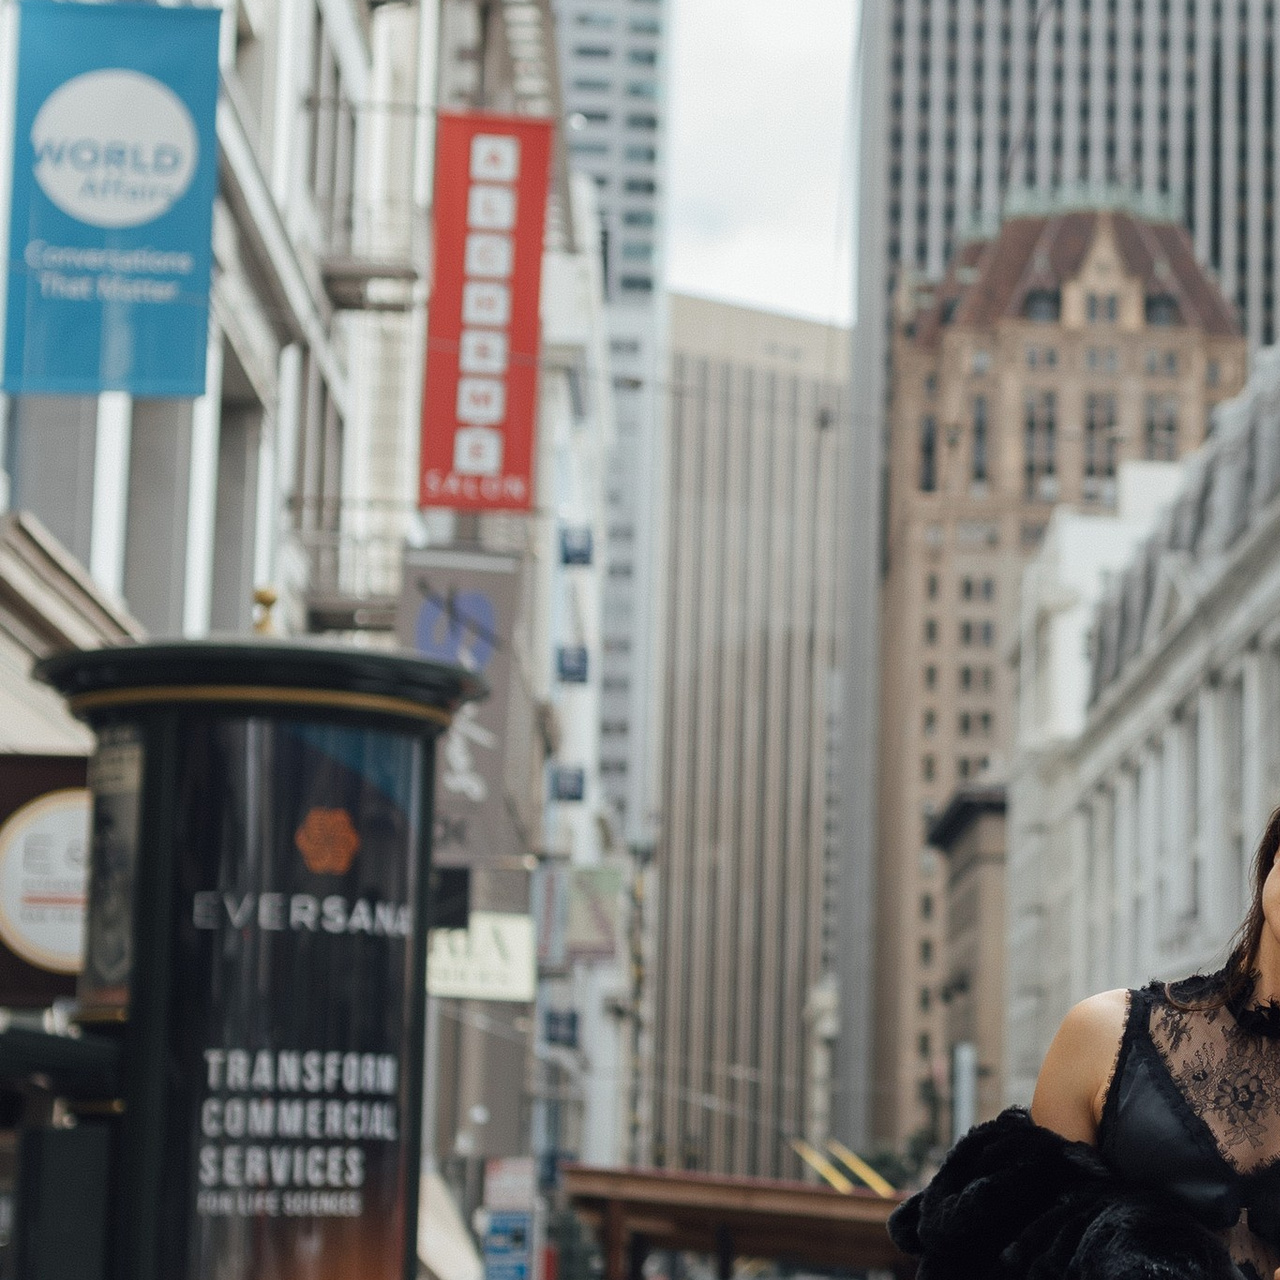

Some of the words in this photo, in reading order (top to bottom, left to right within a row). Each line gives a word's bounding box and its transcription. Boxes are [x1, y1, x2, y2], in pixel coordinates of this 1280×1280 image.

[37, 140, 182, 176] WORLD
[425, 469, 528, 502] SALON
[204, 1047, 398, 1096] TRANSFORM
[201, 1095, 398, 1142] COMMERCIAL
[199, 1143, 365, 1188] SERVICES
